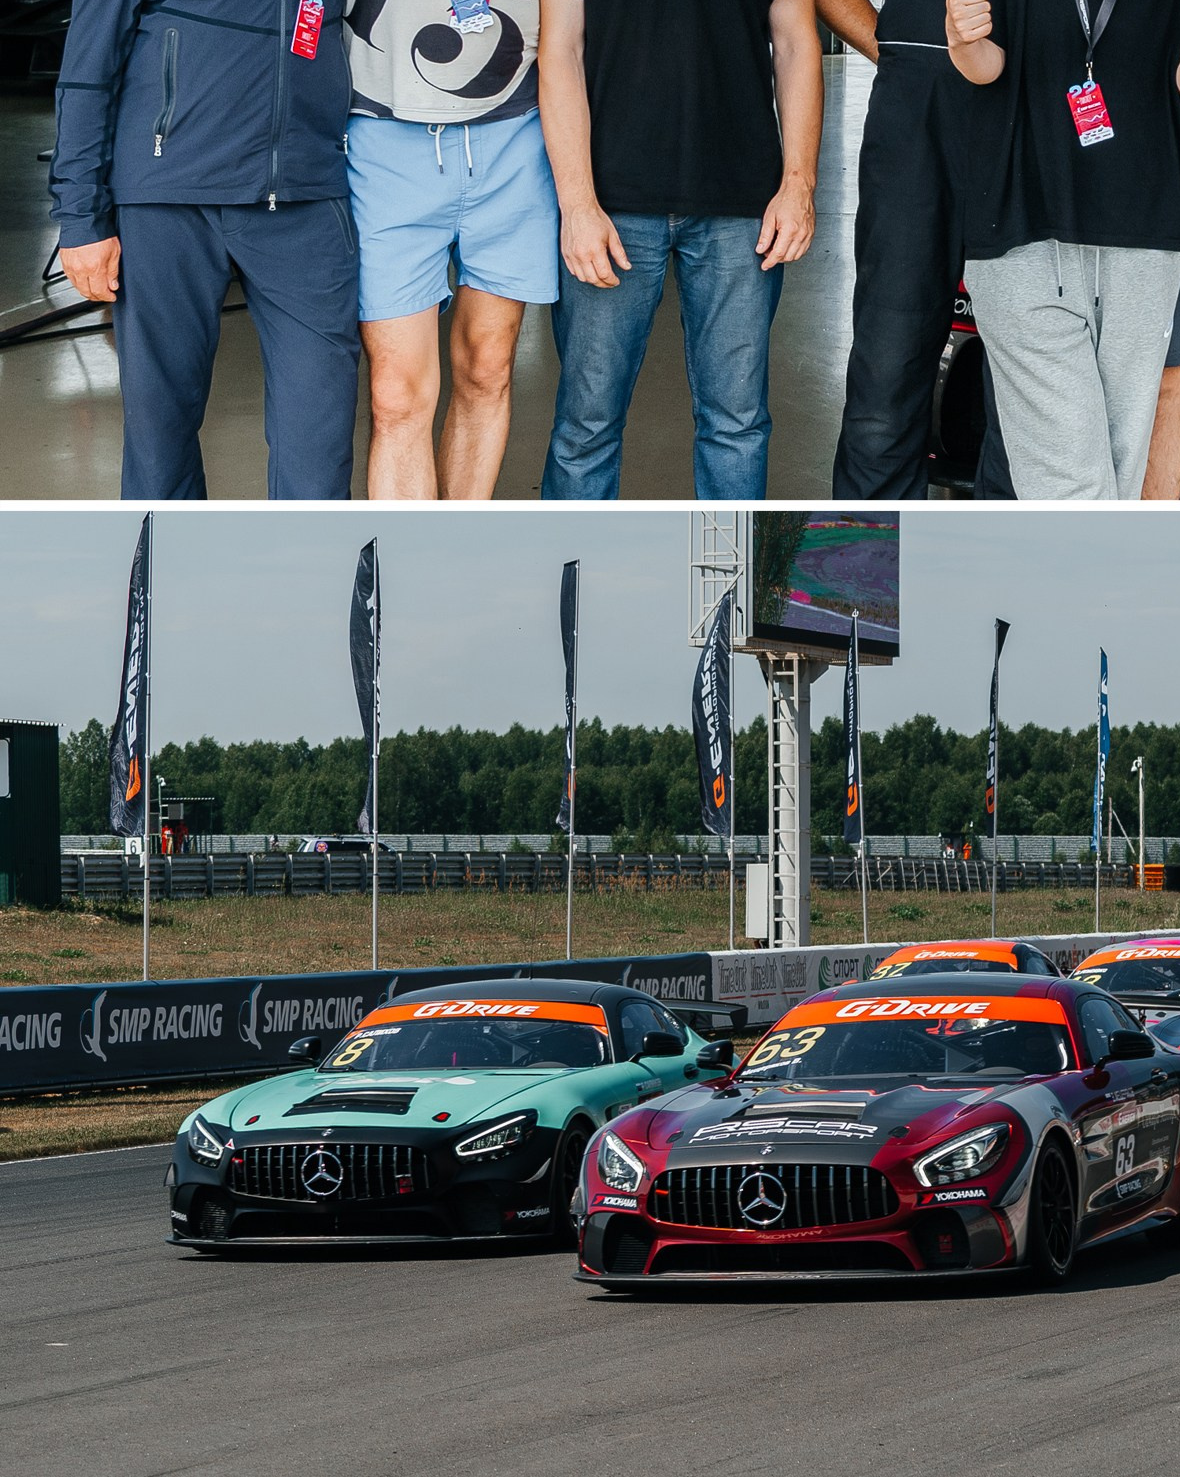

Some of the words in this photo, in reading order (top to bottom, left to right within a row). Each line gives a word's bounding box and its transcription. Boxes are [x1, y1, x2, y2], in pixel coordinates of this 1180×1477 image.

[833, 959, 859, 978] СПОРТ
[662, 973, 706, 1001] RACING
[263, 1000, 304, 1034] SMP
[307, 995, 363, 1031] RACING
[413, 1001, 540, 1019] G-DRIVE
[836, 999, 992, 1018] G-DRIVE
[0, 1011, 62, 1052] ACING
[108, 1009, 148, 1045] SMP
[152, 1002, 223, 1041] RACING
[332, 1037, 375, 1067] 8
[747, 1026, 827, 1068] 63
[688, 1125, 875, 1144] MOTORSPORT
[1115, 1133, 1136, 1178] 63
[602, 1196, 638, 1209] YOKOHAMA
[935, 1189, 986, 1202] YOKOHAMA
[516, 1207, 551, 1219] YOKOHAMA
